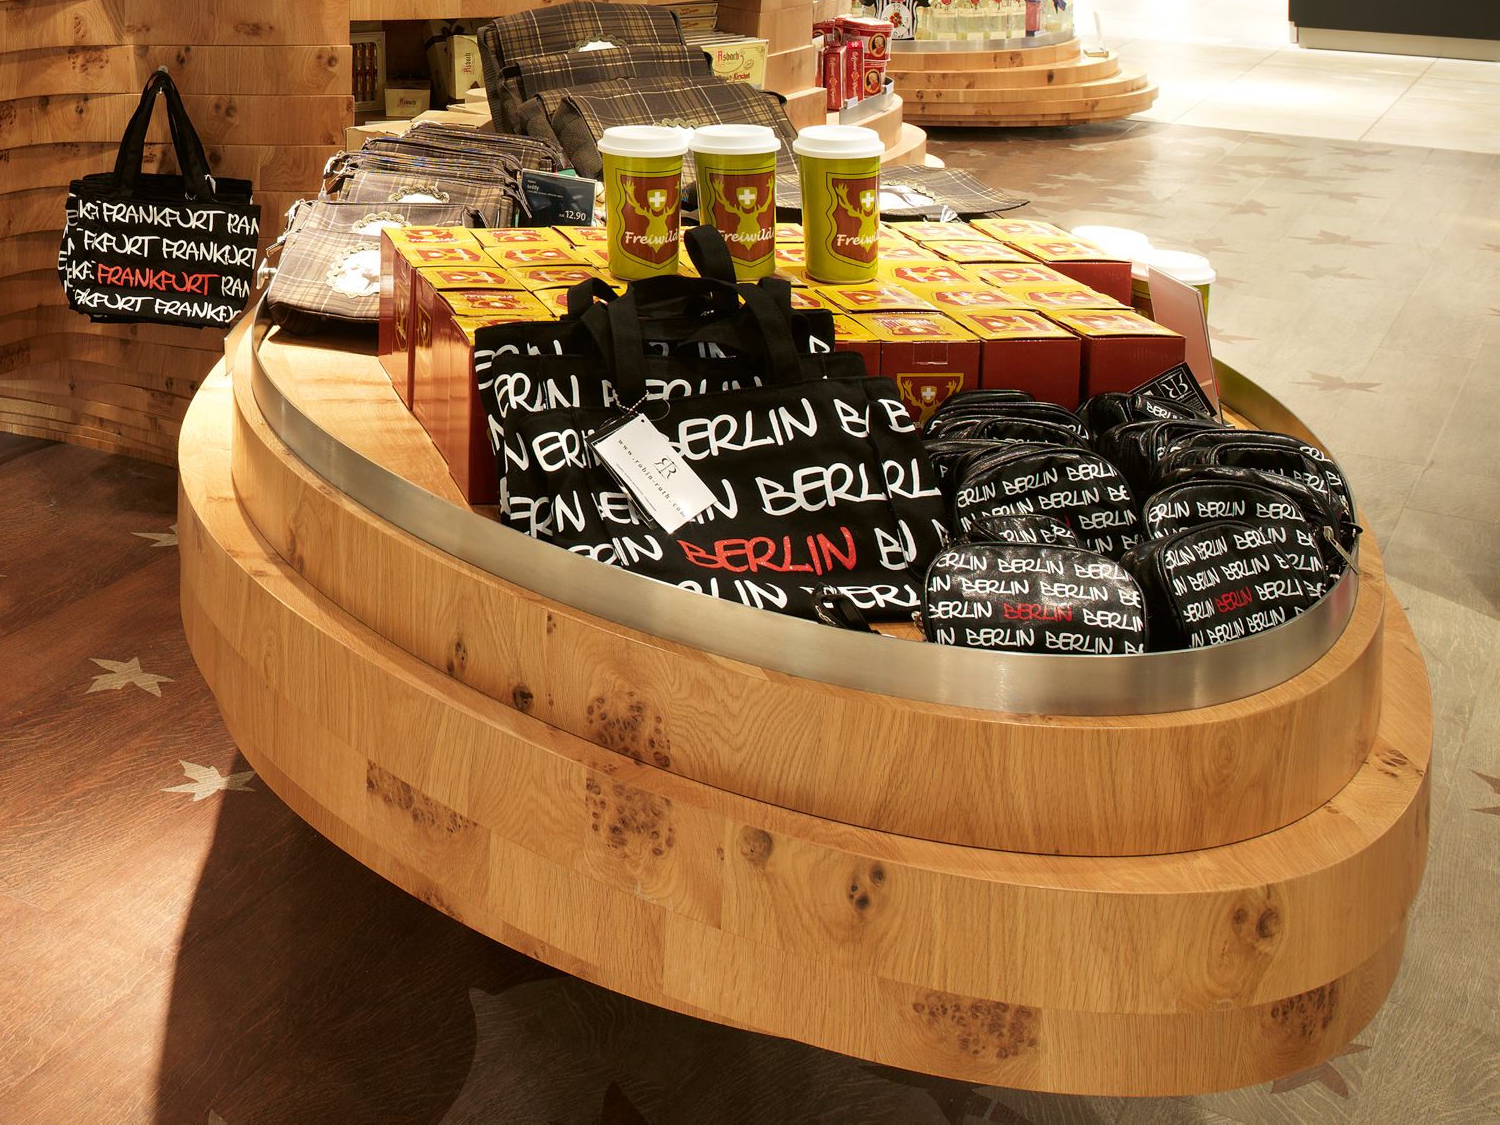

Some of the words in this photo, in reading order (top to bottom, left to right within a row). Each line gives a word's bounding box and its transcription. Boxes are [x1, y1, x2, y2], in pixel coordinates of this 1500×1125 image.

[102, 202, 226, 233] FRANKFURT
[96, 262, 221, 297] FRANKFURT
[1001, 467, 1059, 496] BERLIN
[1038, 487, 1100, 511] BERLIN
[1196, 499, 1246, 519] BERLIN
[676, 526, 858, 576] BERLIN
[1192, 535, 1229, 562] BERLIN
[1233, 526, 1287, 551] BERLIN
[996, 557, 1065, 576] BERLIN
[1187, 566, 1222, 592] BERLIN
[1219, 553, 1272, 581] BERLIN
[960, 577, 1030, 596] BERLIN
[1040, 580, 1110, 603] BERLIN
[1214, 586, 1254, 614] BERLIN
[1002, 602, 1074, 623] BERLIN
[1207, 620, 1246, 647] BERLIN
[1245, 606, 1287, 633] BERLIN
[965, 627, 1036, 647] BERLIN
[1044, 630, 1115, 655] BERLIN
